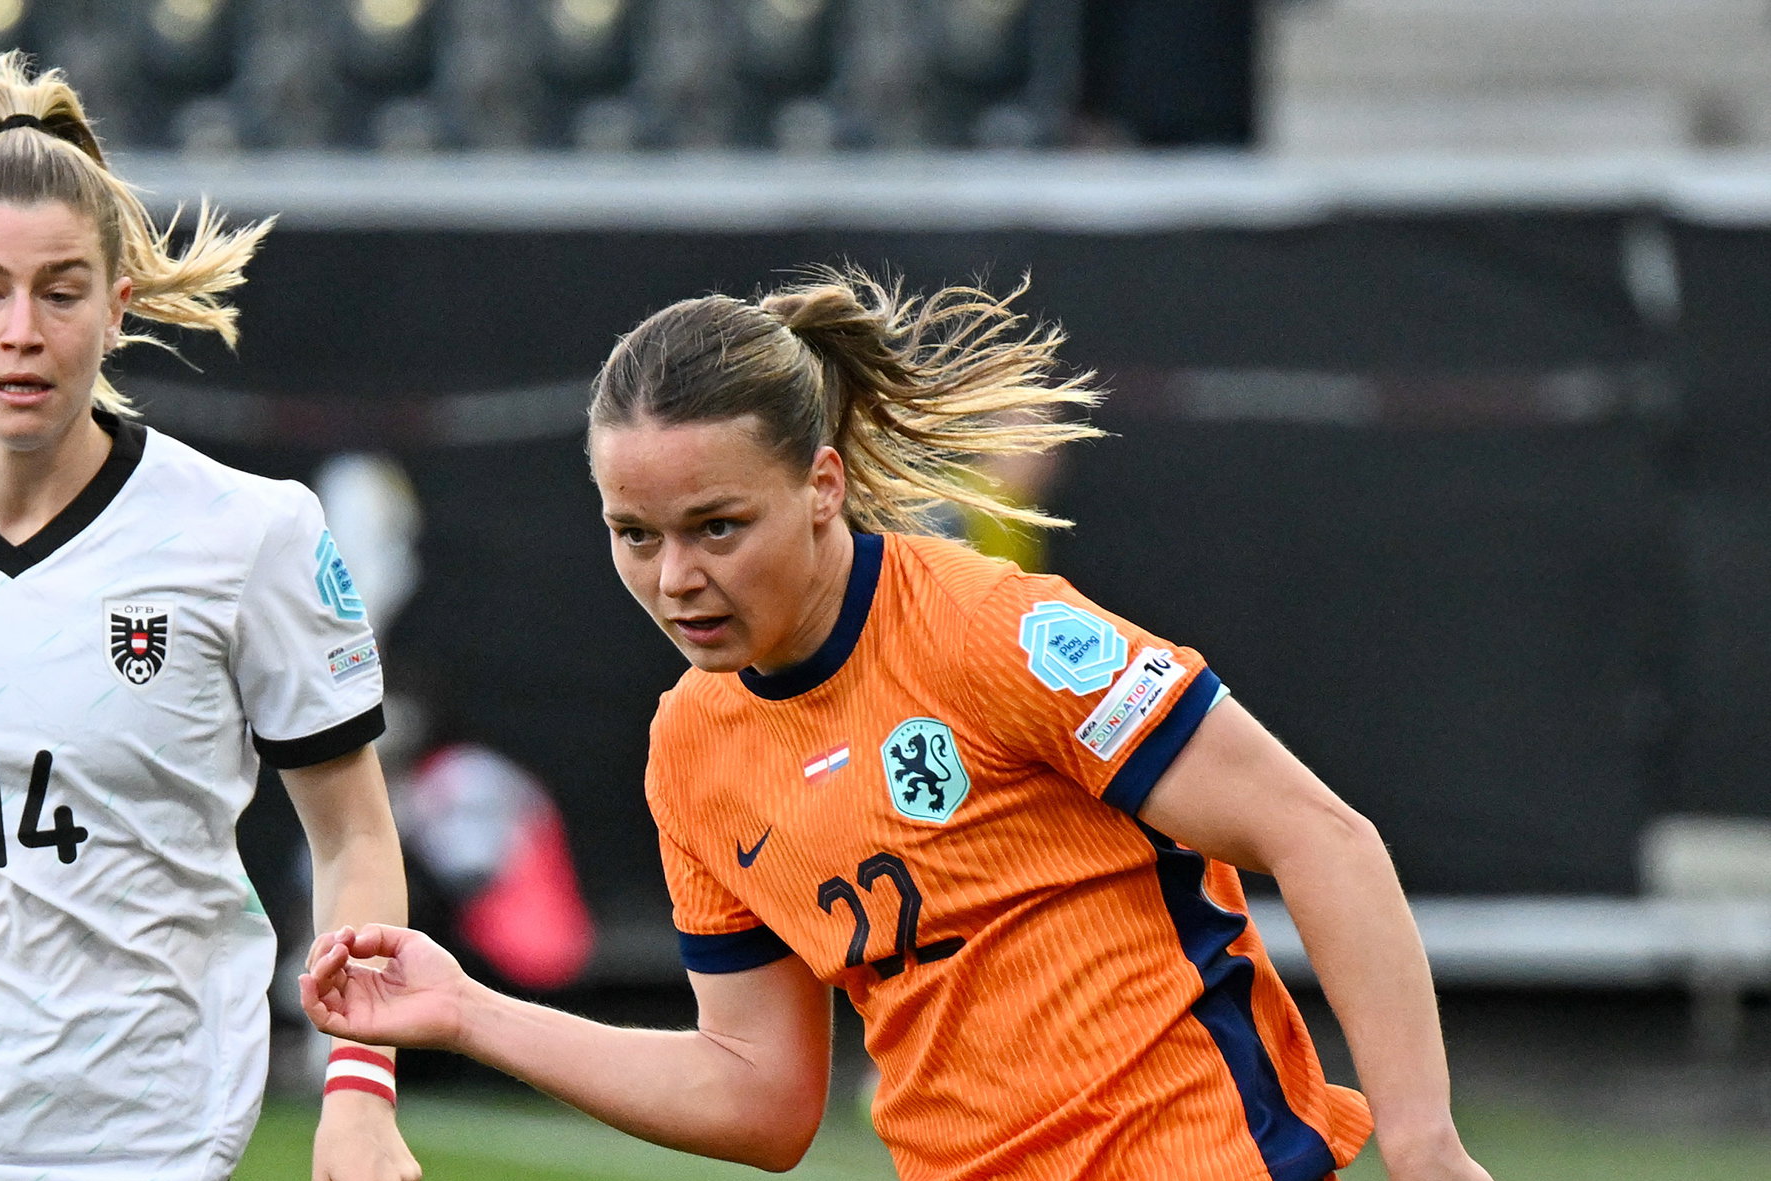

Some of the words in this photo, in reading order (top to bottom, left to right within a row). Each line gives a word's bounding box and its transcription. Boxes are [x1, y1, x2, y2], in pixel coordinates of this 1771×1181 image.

[1049, 633, 1066, 647] We
[1059, 636, 1082, 656] Play
[1069, 635, 1100, 664] Strong
[1089, 676, 1153, 750] FOUNDATION
[817, 851, 968, 981] 22
